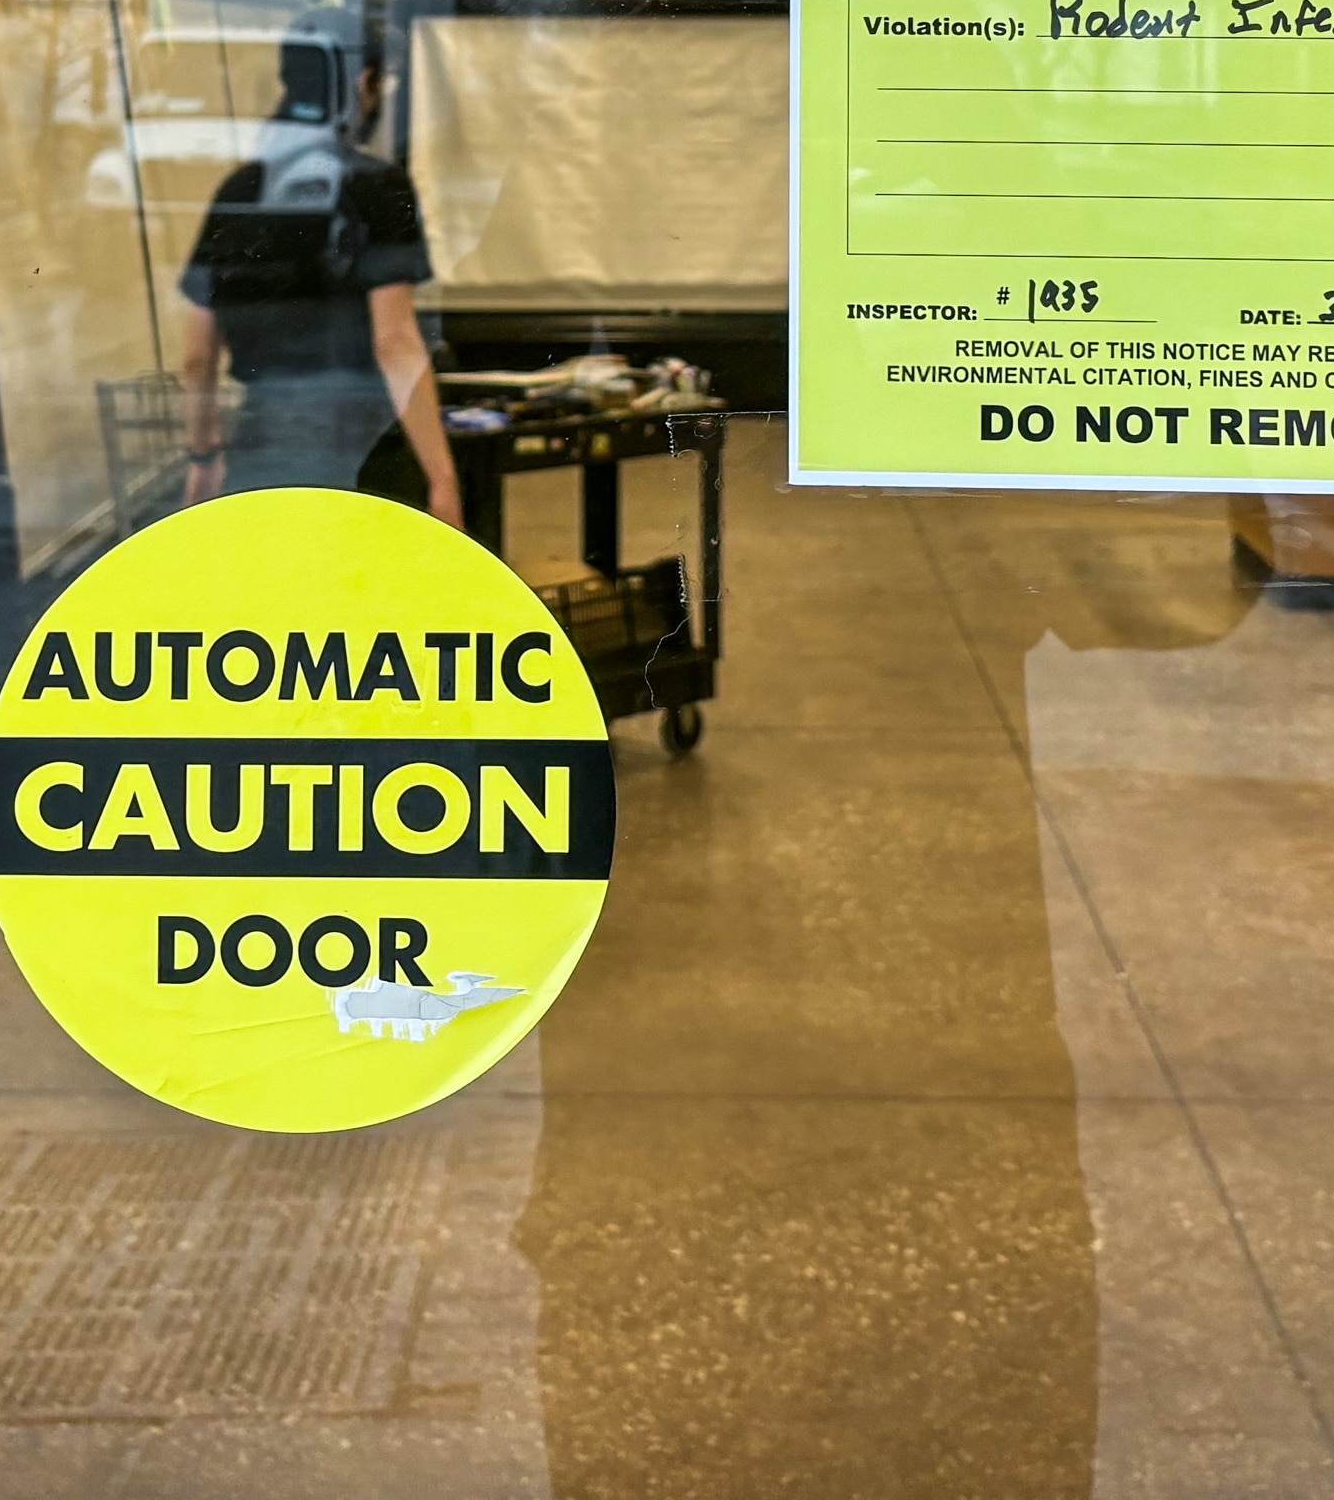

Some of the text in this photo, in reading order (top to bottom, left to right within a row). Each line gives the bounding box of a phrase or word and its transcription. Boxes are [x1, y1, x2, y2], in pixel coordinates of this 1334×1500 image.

[863, 16, 1024, 41] Violation(s):
[847, 304, 977, 321] INSPECTOR:
[1240, 309, 1301, 326] DATE:
[956, 340, 1064, 358] REMOVAL
[1070, 341, 1100, 359] OF
[1105, 341, 1155, 360] THIS
[1163, 343, 1245, 361] NOTICE
[1253, 344, 1301, 362] MAY
[887, 366, 1076, 385] ENVIRONMENTAL
[1082, 369, 1192, 390] CITATION,
[1199, 370, 1263, 388] FINES
[1270, 371, 1317, 389] AND
[980, 404, 1055, 442] DO
[1076, 406, 1189, 444] NOT
[22, 628, 553, 704] AUTOMATIC
[13, 760, 571, 855] CAUTION
[156, 913, 434, 988] DOOR
